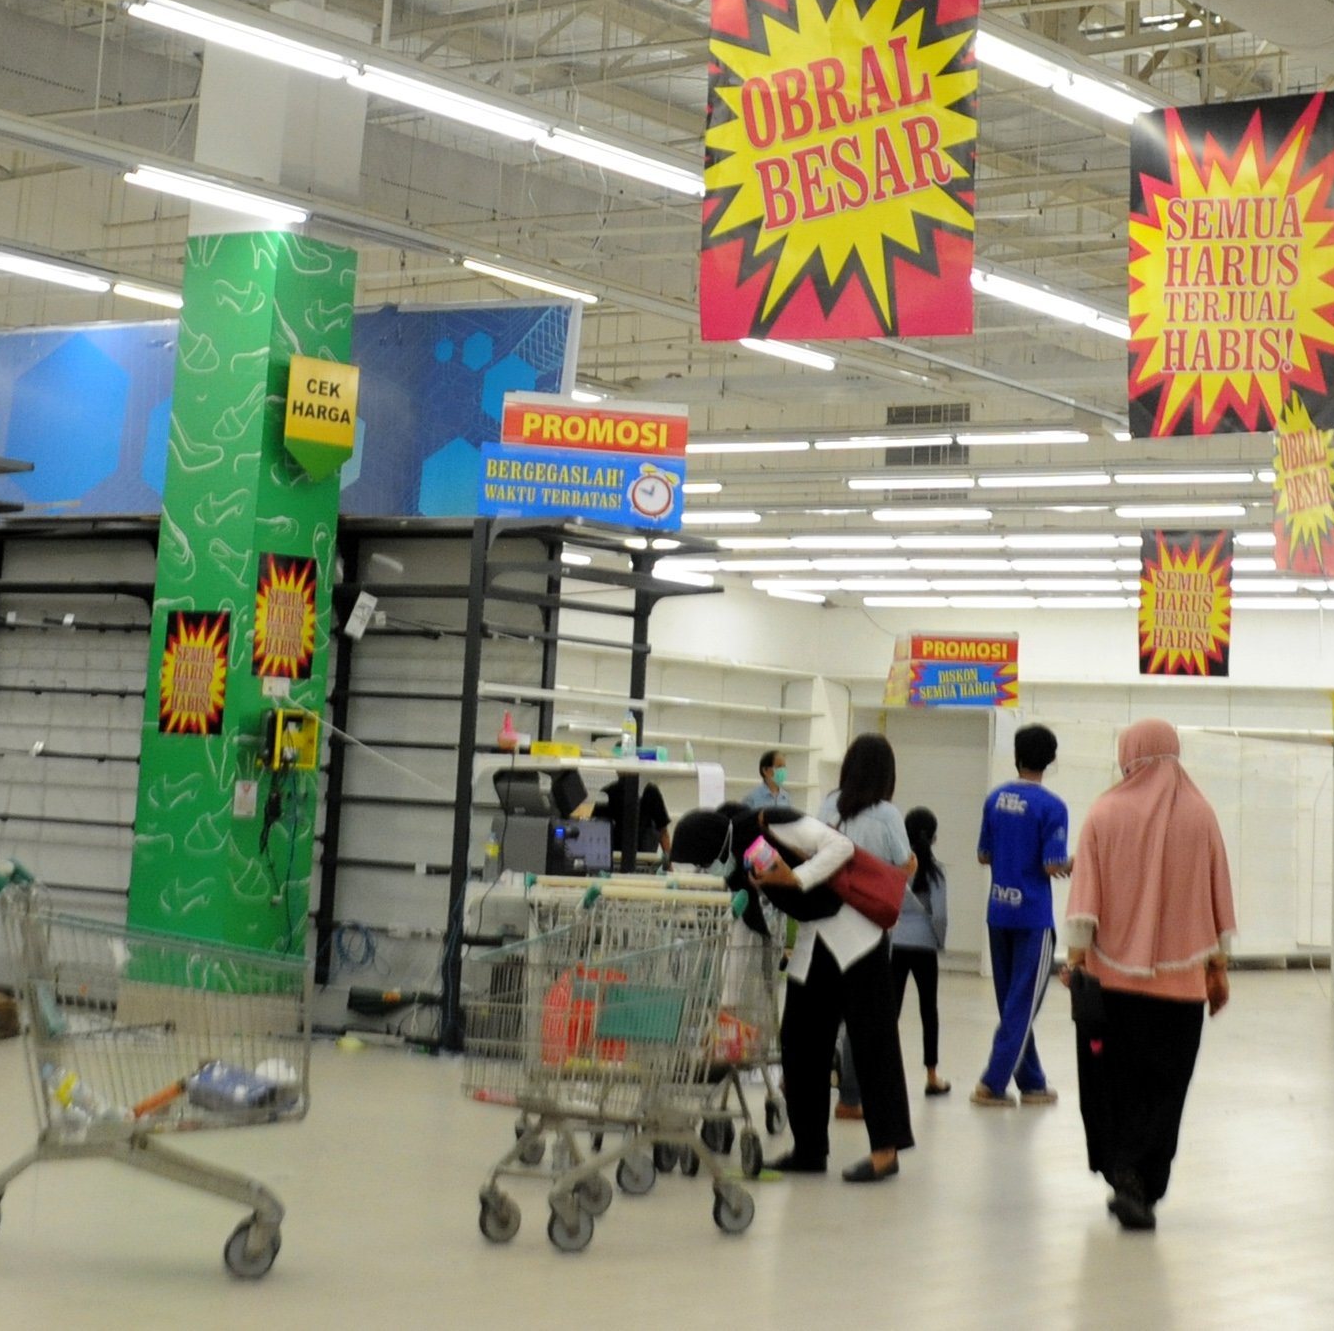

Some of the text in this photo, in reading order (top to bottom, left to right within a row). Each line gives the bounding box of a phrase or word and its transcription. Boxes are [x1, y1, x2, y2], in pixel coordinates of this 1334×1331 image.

[740, 35, 931, 152] OBRAL
[756, 115, 953, 231] BESAR
[1166, 195, 1303, 243] SEMUA
[1166, 242, 1300, 288] HARUS
[1165, 289, 1295, 324] TERJUAL
[1162, 328, 1294, 375] HABIS!
[306, 378, 341, 400] CEK
[292, 400, 351, 426] HARGA
[523, 412, 667, 448] PROMOSI
[1279, 428, 1327, 472] OBRAL
[486, 458, 625, 488] BERGEGASLAH!
[485, 483, 623, 510] WAKTU TERBATAS!
[1154, 570, 1216, 594] SEMUA
[1153, 592, 1214, 614] HARUS
[1153, 610, 1211, 630] TERJUAL
[922, 640, 1008, 661] PROMOSI
[1152, 628, 1211, 652] HABIS!
